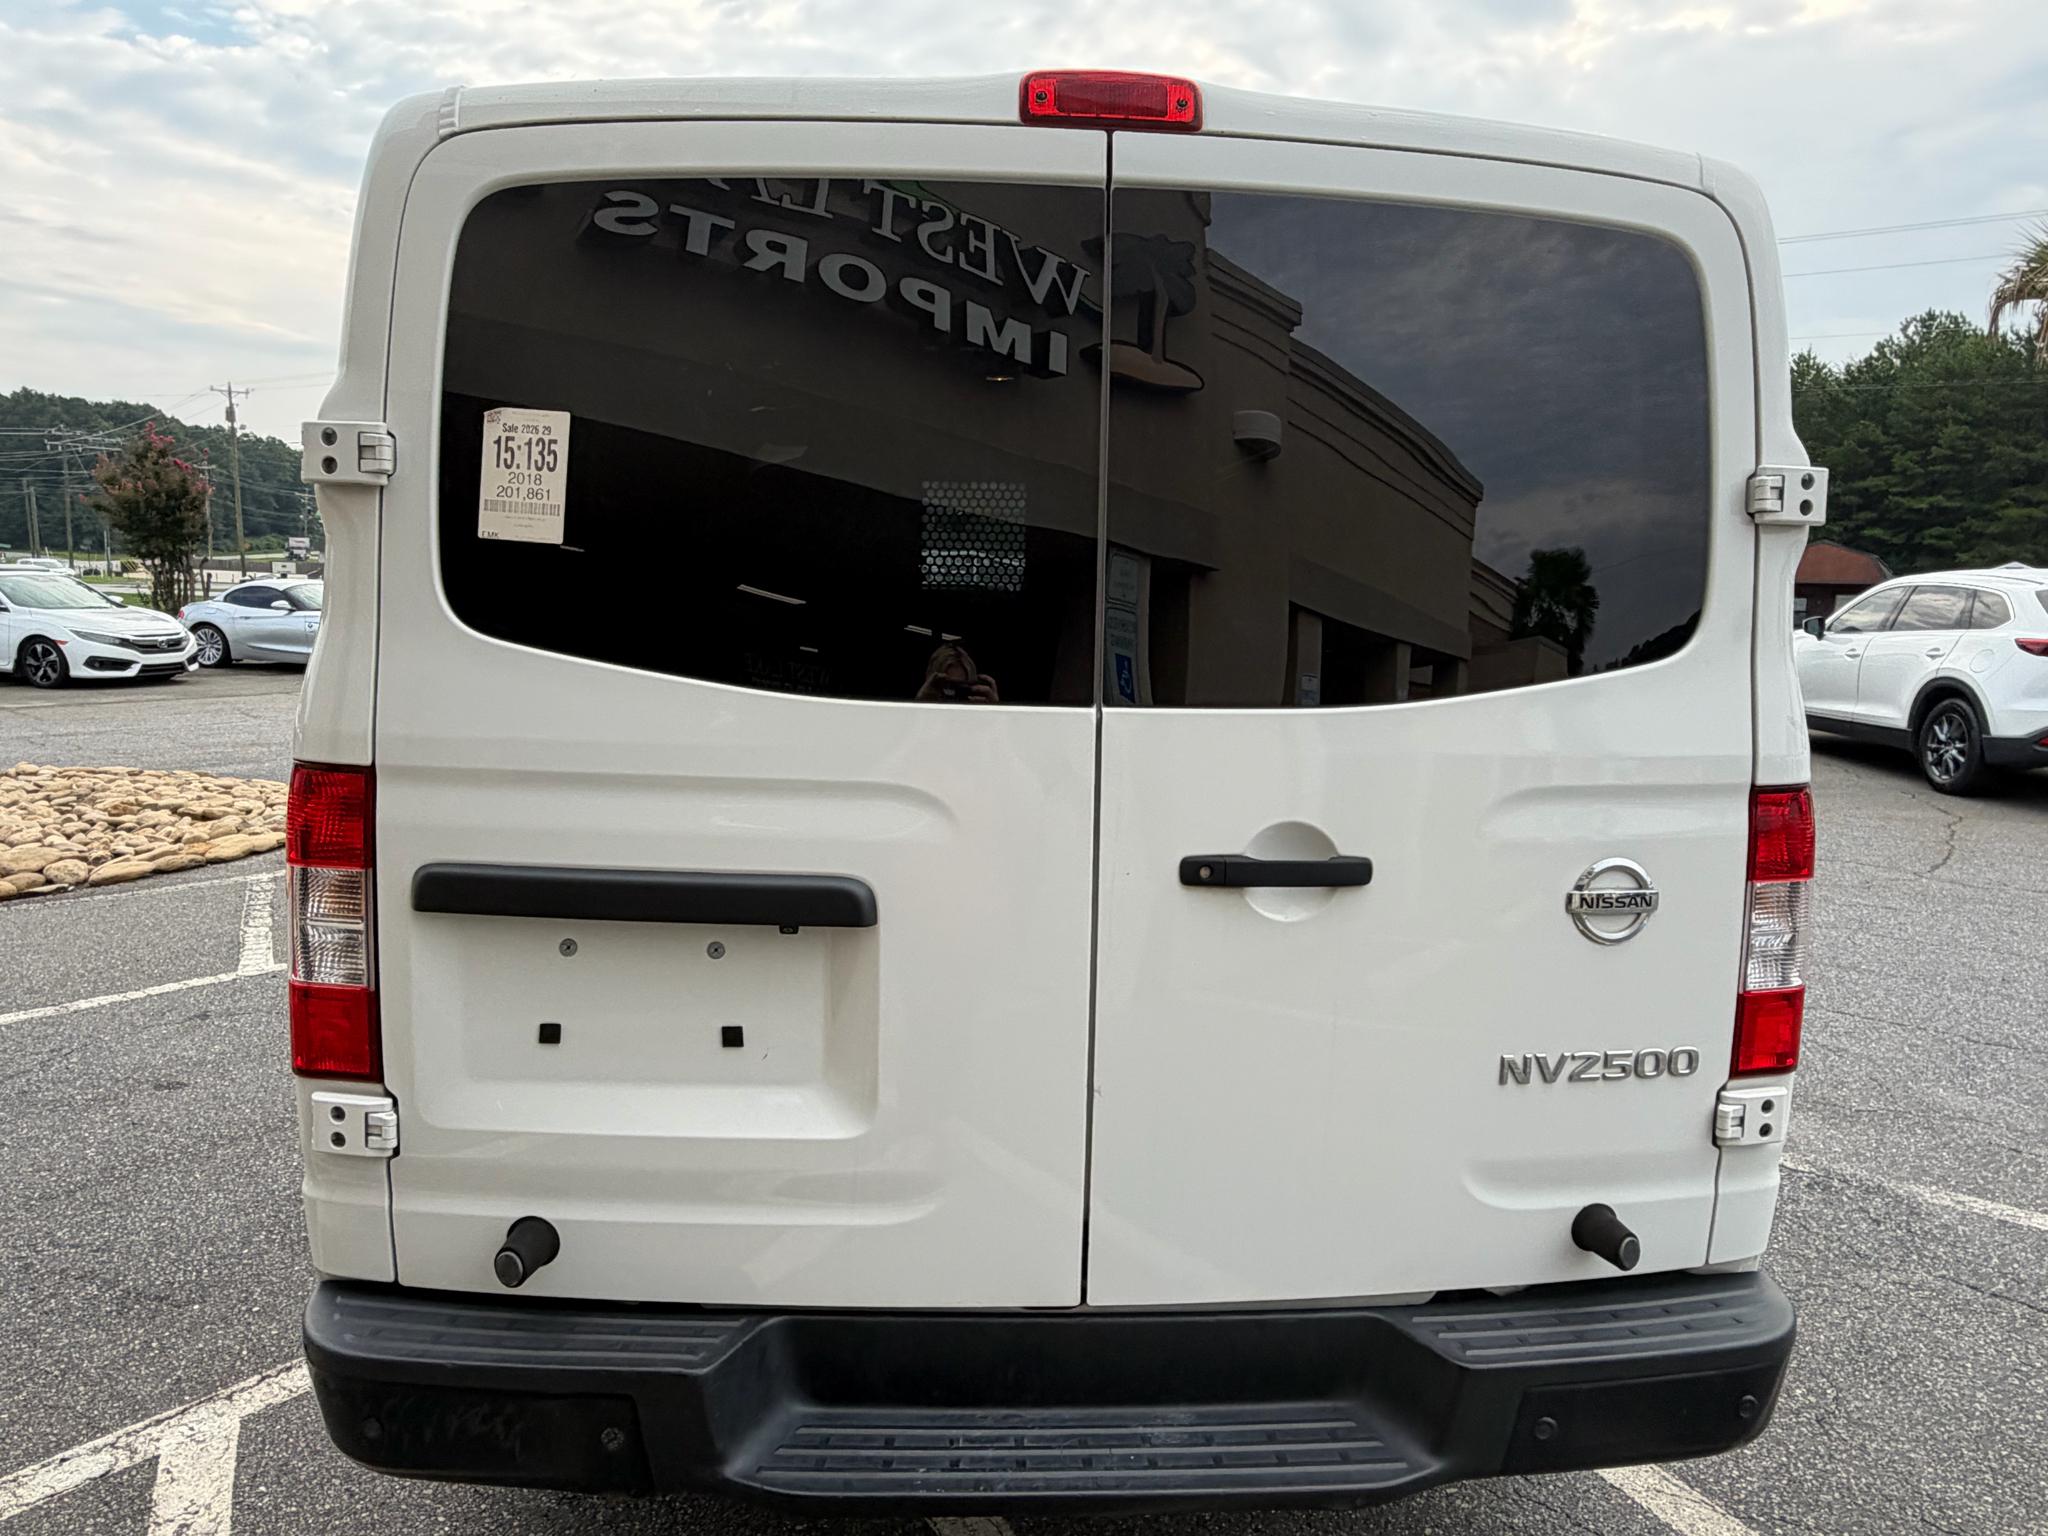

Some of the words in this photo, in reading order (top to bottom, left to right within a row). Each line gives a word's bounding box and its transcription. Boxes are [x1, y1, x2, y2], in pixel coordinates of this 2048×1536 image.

[502, 422, 519, 434] Sale
[492, 435, 559, 473] 15:135
[508, 471, 543, 486] 2018
[496, 485, 551, 501] 201,861
[1580, 895, 1653, 909] NISSAN
[1498, 1046, 1700, 1086] NV2500
